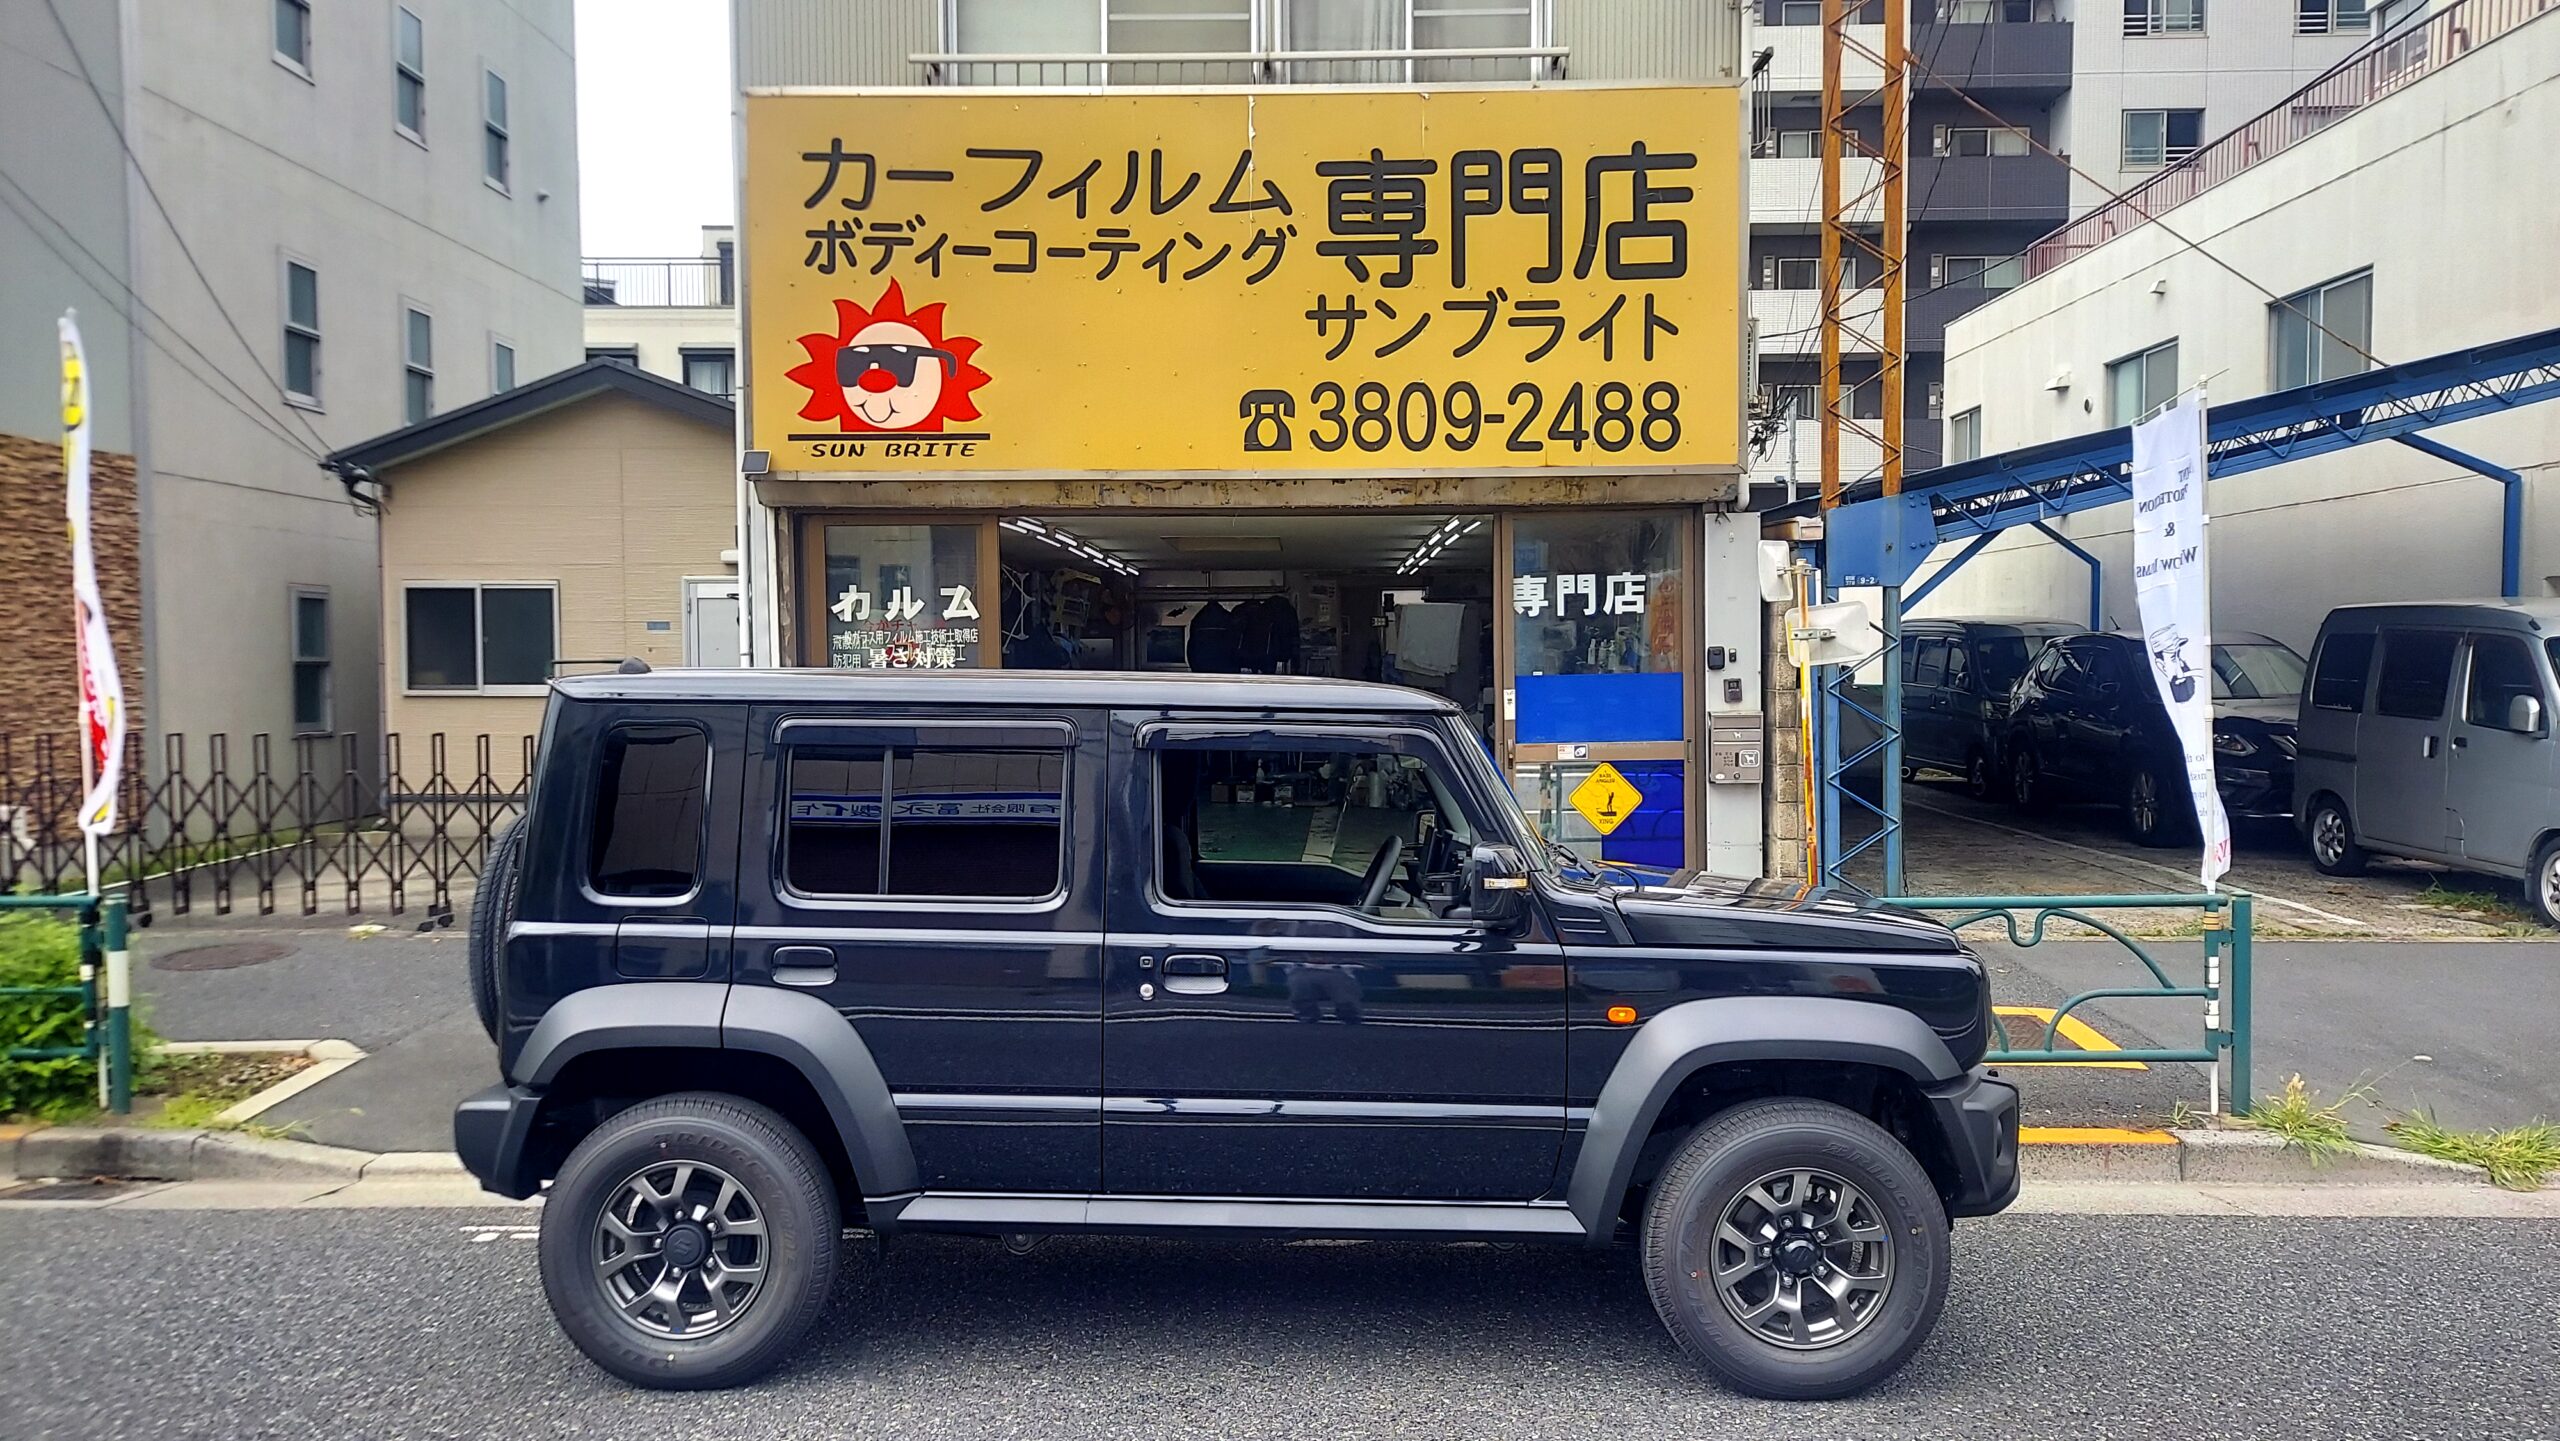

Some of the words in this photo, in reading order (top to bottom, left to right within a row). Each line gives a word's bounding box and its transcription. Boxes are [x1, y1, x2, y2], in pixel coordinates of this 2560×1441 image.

[802, 137, 1293, 219] カーフィルム
[804, 214, 1297, 285] ボディーコーティング
[1315, 140, 1697, 288] 専門店
[1305, 287, 1678, 362] サンブライト
[811, 443, 865, 458] SUN
[885, 442, 977, 457] BRITE
[1310, 381, 1681, 451] 3809-2488
[1512, 572, 1647, 617] 専門店
